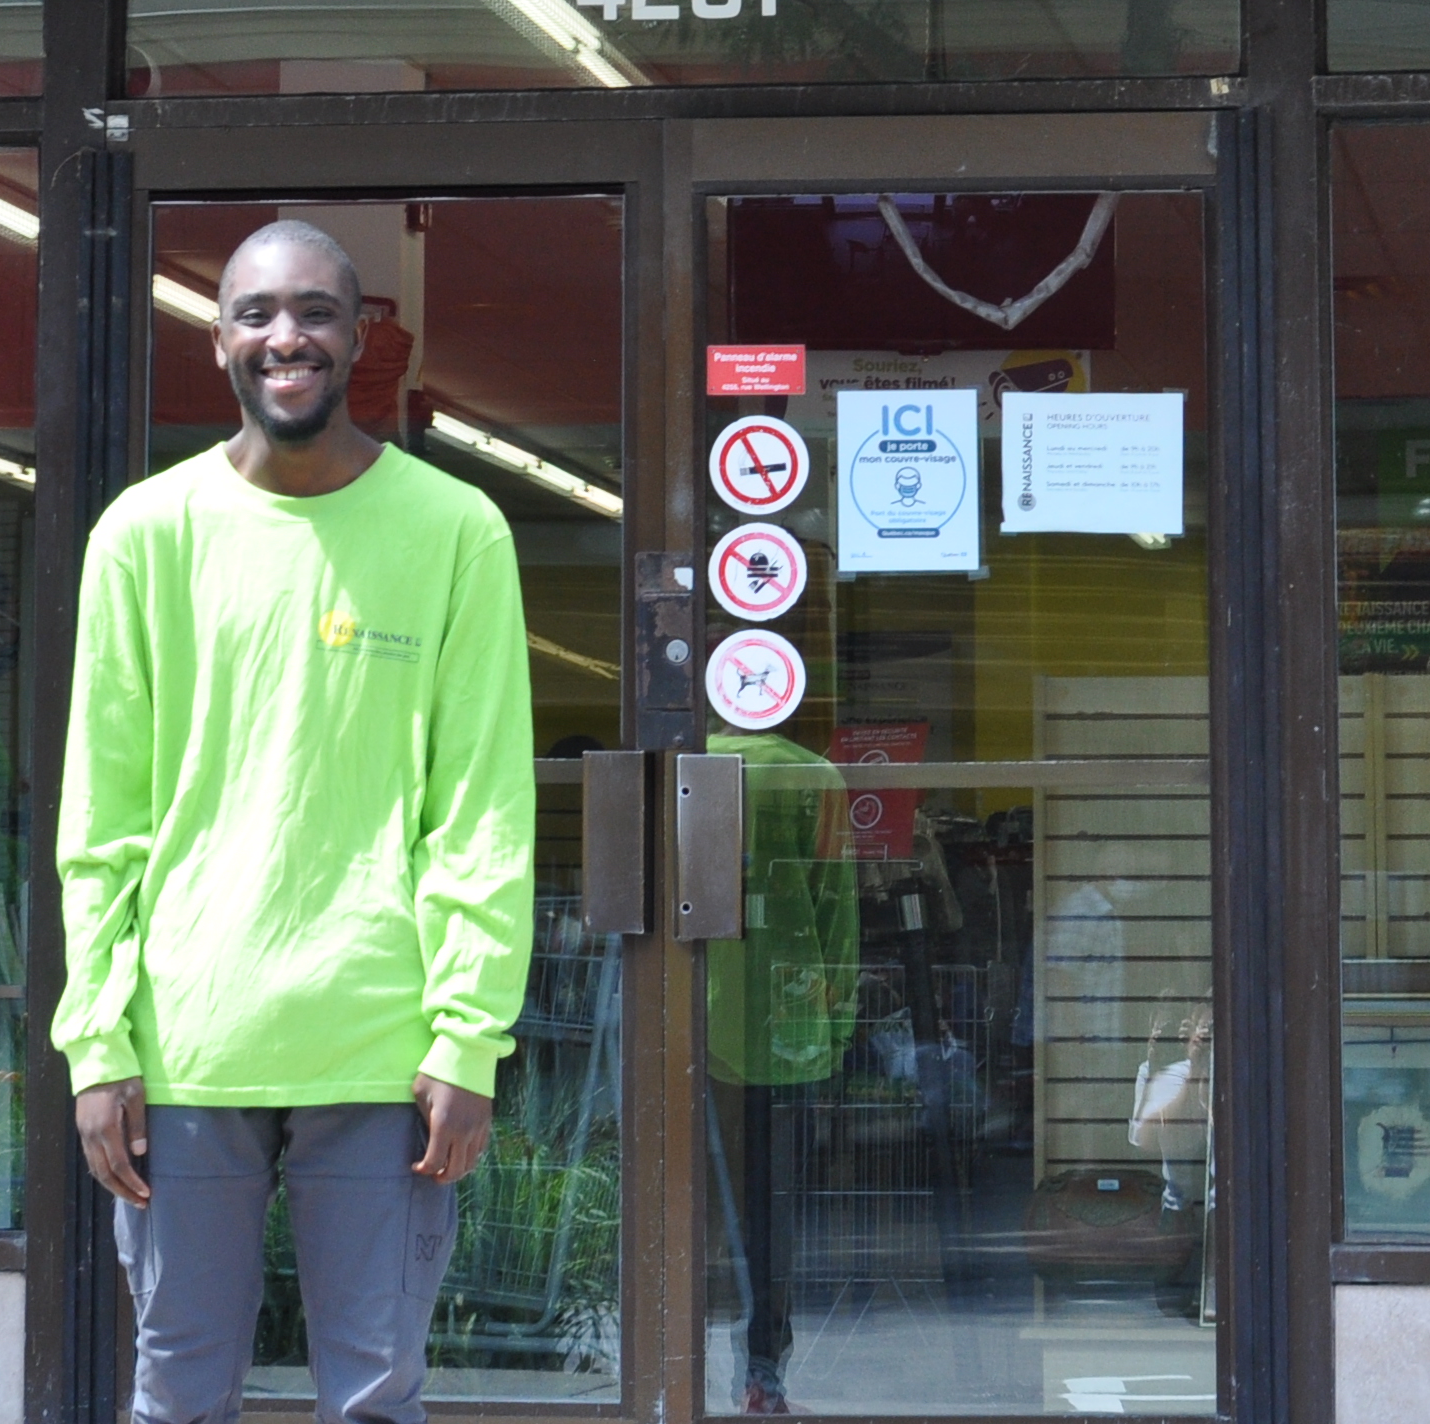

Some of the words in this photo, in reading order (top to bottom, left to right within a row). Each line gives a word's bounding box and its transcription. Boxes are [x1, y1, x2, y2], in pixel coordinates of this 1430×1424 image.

[714, 353, 755, 361] Panneau
[757, 353, 797, 361] d'alarme
[736, 364, 775, 372] incendie
[853, 358, 923, 374] Souriez,
[864, 376, 901, 389] êtes
[882, 405, 933, 436] ICI
[887, 442, 897, 452] je
[899, 442, 928, 451] porte
[885, 455, 957, 464] couvre-visage
[1021, 423, 1033, 506] RENAISSANCE
